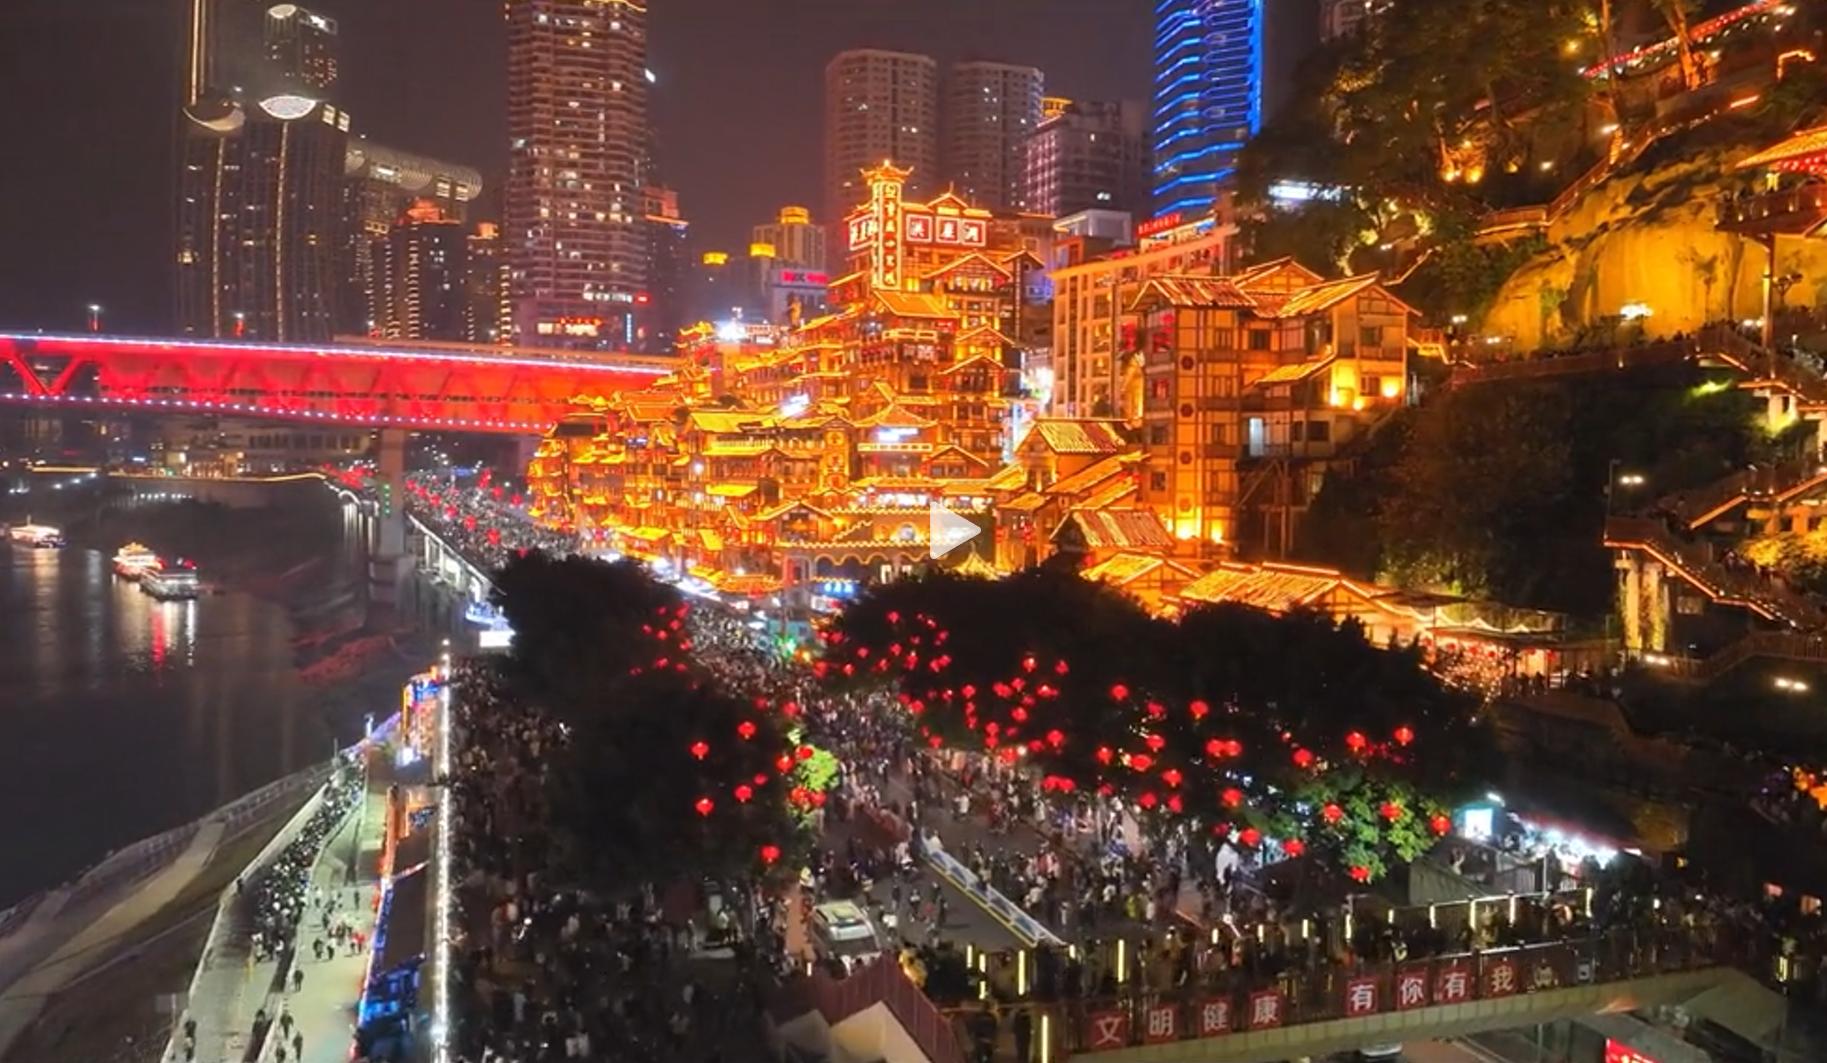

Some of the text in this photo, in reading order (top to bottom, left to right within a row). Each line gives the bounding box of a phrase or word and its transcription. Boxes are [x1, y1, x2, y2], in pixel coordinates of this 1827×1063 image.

[1095, 966, 1514, 1046] 文明健康 有你有我
